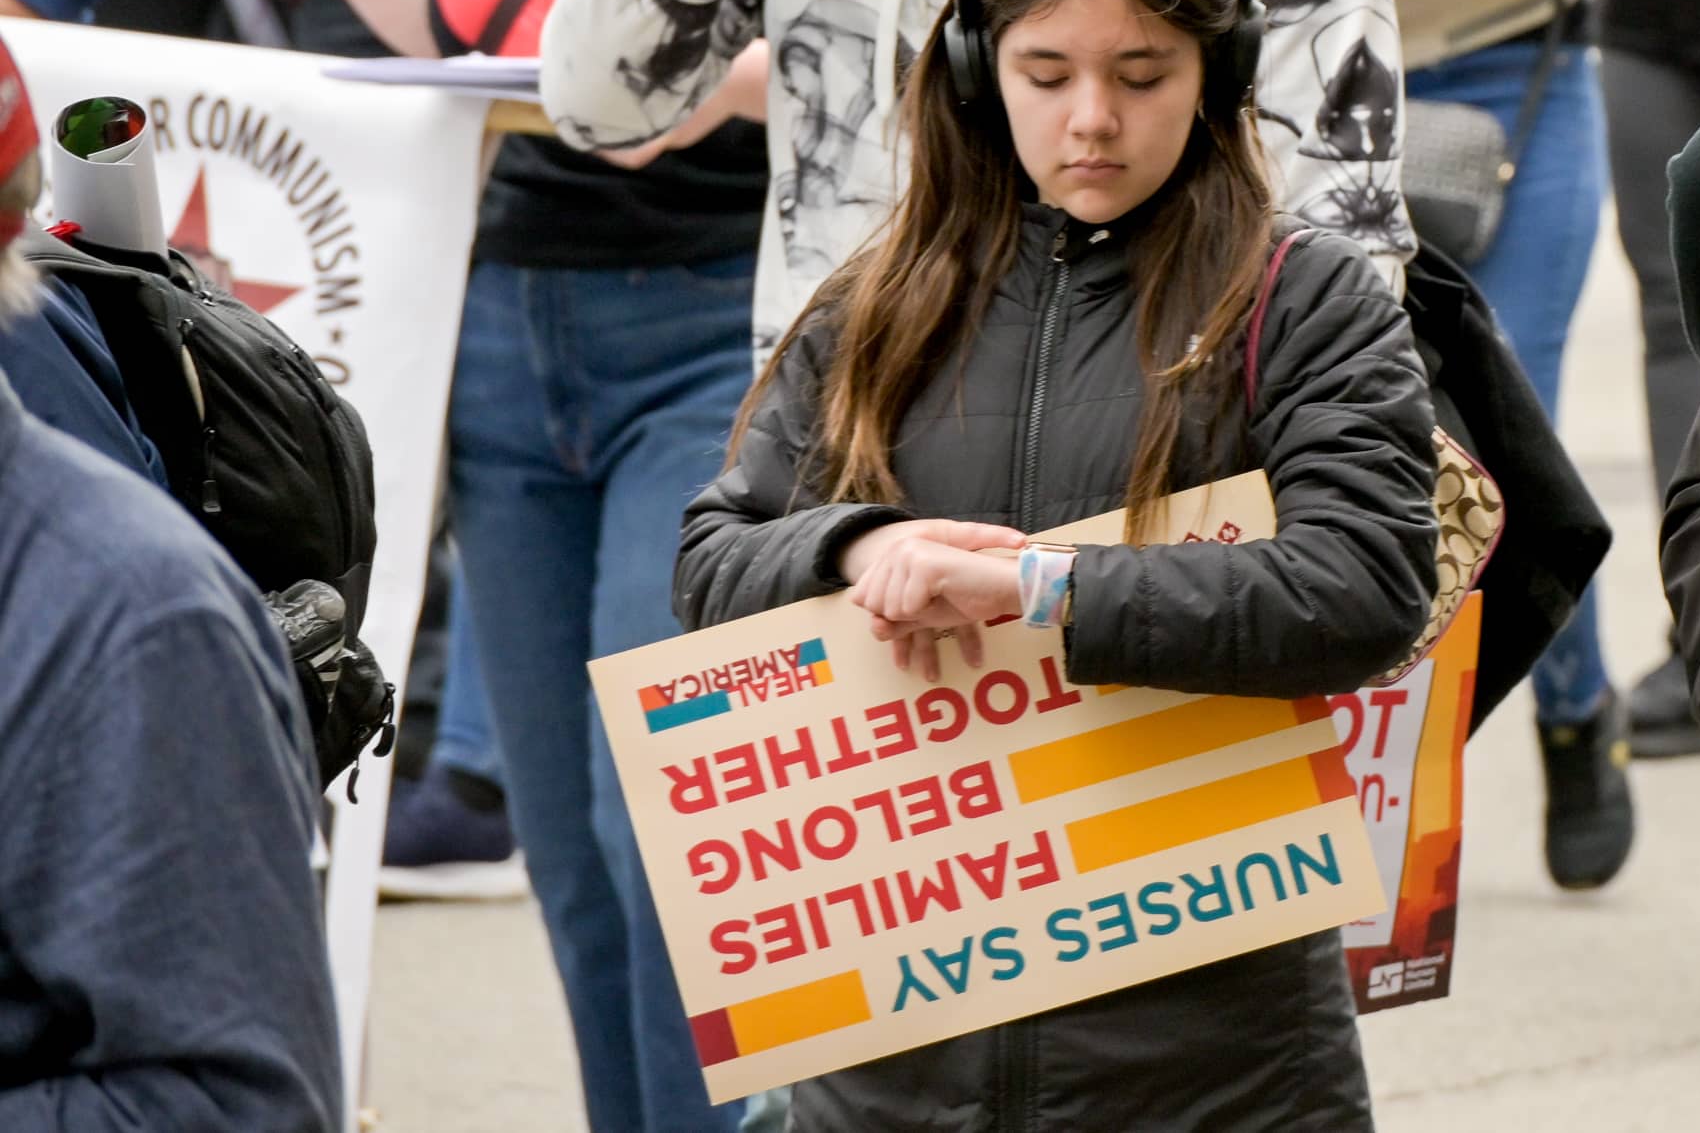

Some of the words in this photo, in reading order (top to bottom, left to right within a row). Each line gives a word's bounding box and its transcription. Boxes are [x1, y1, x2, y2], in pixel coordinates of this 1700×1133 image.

[186, 92, 366, 315] COMMUNISM
[656, 643, 802, 704] AMERICA
[660, 655, 1082, 815] TOGETHER
[725, 665, 818, 707] HEAL
[687, 760, 1003, 894] BELONG
[709, 830, 1061, 976] FAMILIES
[1045, 832, 1343, 962] NURSES
[891, 926, 1027, 1013] SAY
